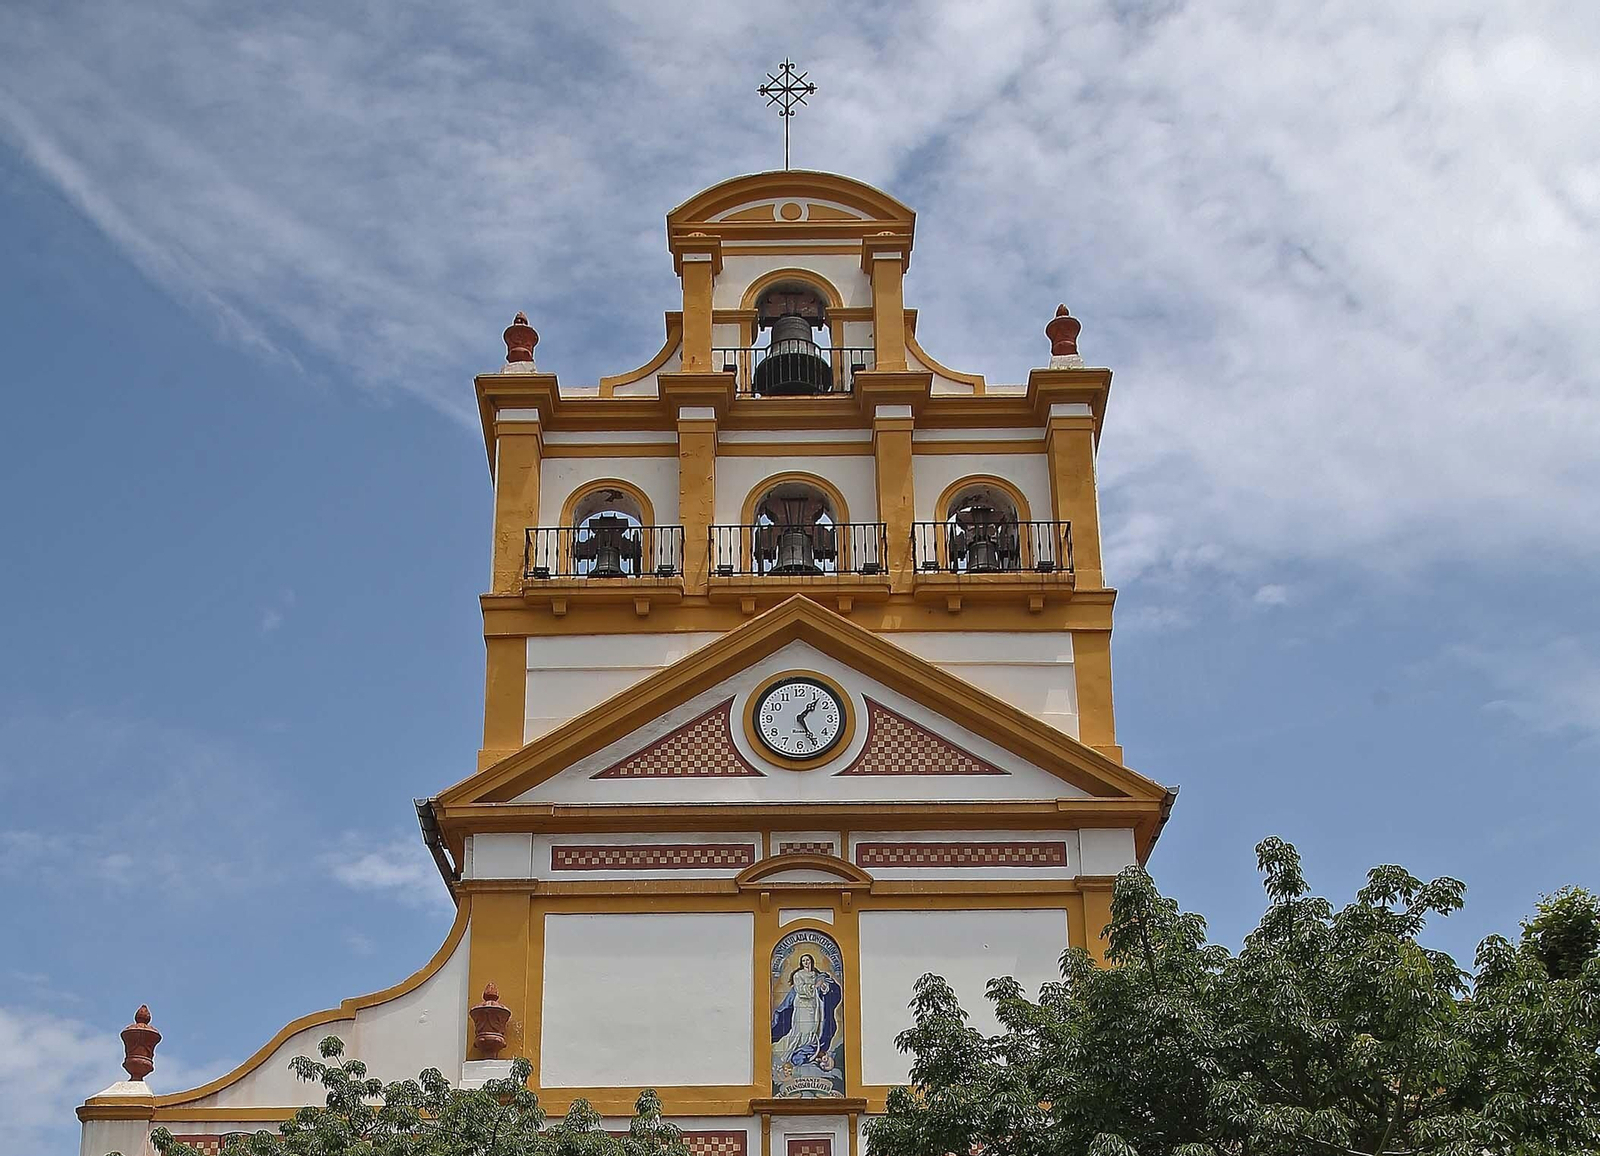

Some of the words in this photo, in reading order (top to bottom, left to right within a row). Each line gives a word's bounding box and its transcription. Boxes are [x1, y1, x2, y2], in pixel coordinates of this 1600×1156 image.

[781, 693, 790, 701] 11
[794, 689, 805, 697] 12
[771, 703, 782, 711] 10
[822, 701, 829, 710] 2
[766, 715, 773, 723] 9
[827, 715, 833, 723] 3
[771, 728, 778, 736] 8
[821, 727, 828, 736] 4
[782, 737, 789, 746] 7
[797, 741, 803, 749] 6
